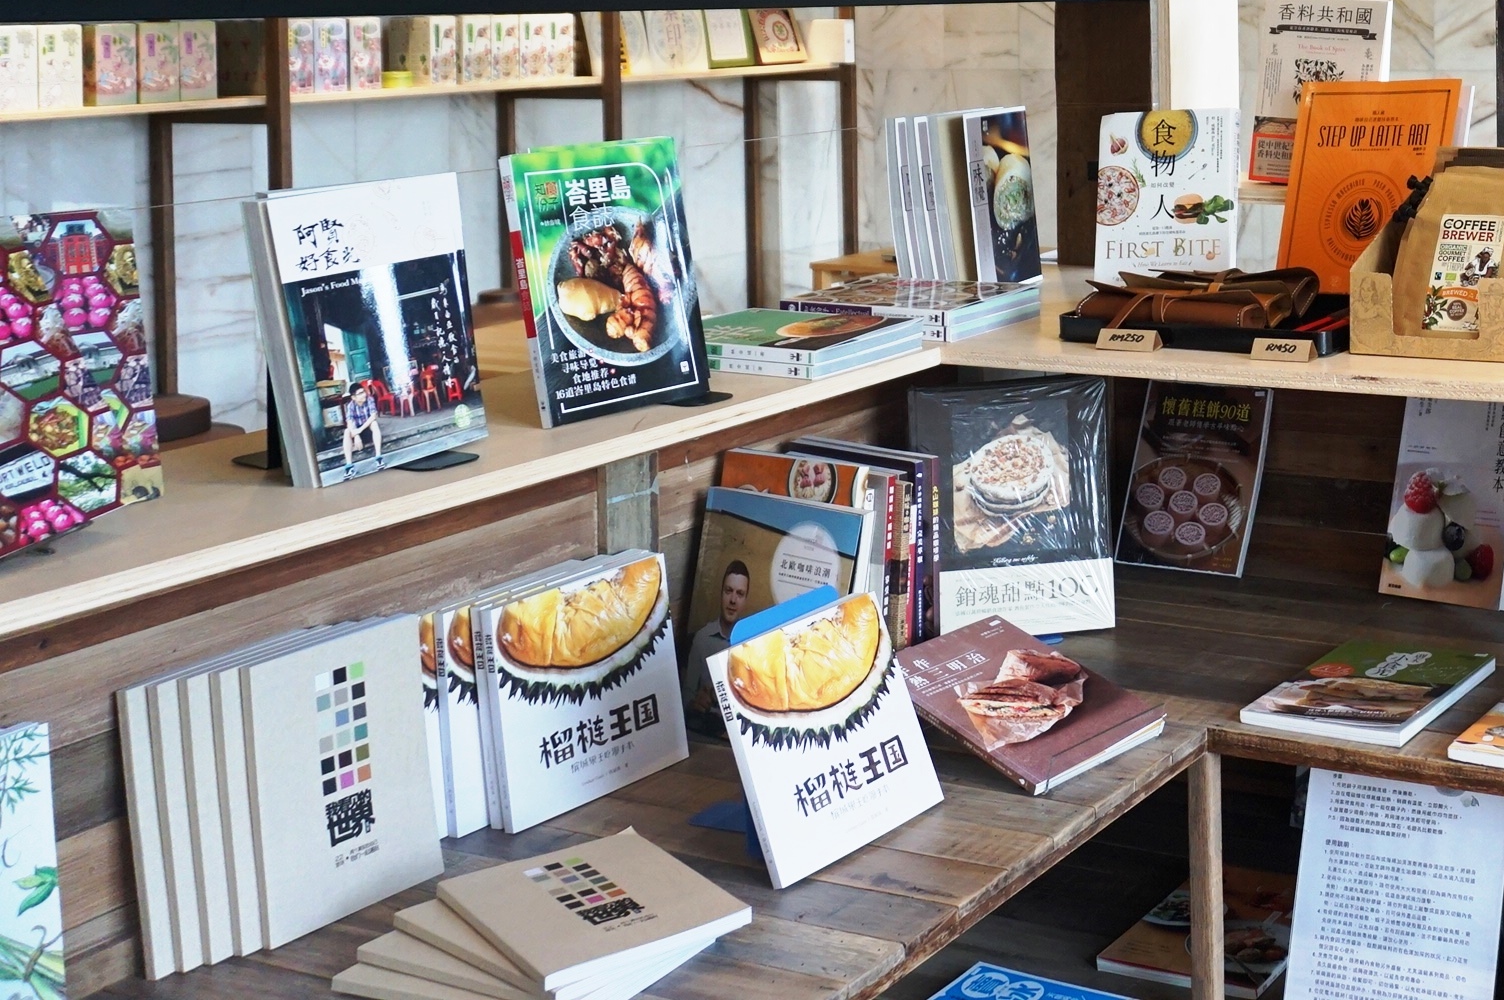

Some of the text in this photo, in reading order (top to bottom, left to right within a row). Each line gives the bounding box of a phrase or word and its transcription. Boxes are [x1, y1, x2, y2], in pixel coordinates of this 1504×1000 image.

[1278, 3, 1373, 25] 香料共和國
[1257, 139, 1295, 150] 從中世紀
[1318, 123, 1431, 147] STEP UP LATTE ART
[1151, 119, 1177, 177] 食物
[565, 175, 631, 206] 峇里島
[569, 203, 616, 232] 食誌
[1150, 194, 1175, 221] 人
[293, 218, 344, 248] 阿賢
[1442, 230, 1494, 242] BREWER
[1443, 219, 1496, 231] COFFEE
[295, 246, 361, 272] 好食光
[1174, 237, 1222, 258] BITE
[301, 279, 350, 297] Jason's Food
[1442, 289, 1468, 297] BREWED
[1108, 333, 1144, 343] RM250
[1265, 343, 1297, 354] RM50
[561, 360, 598, 374] 寻味导览
[572, 369, 609, 384] 食地推荐
[1162, 395, 1251, 423] 懷舊糕餅90道
[780, 559, 831, 579] 北歐咖啡浪潮
[956, 575, 1098, 607] 銷魂甜點100
[908, 652, 986, 689] 熱三明治
[539, 693, 660, 769] 榴梿王国
[795, 735, 909, 817] 榴梿王国
